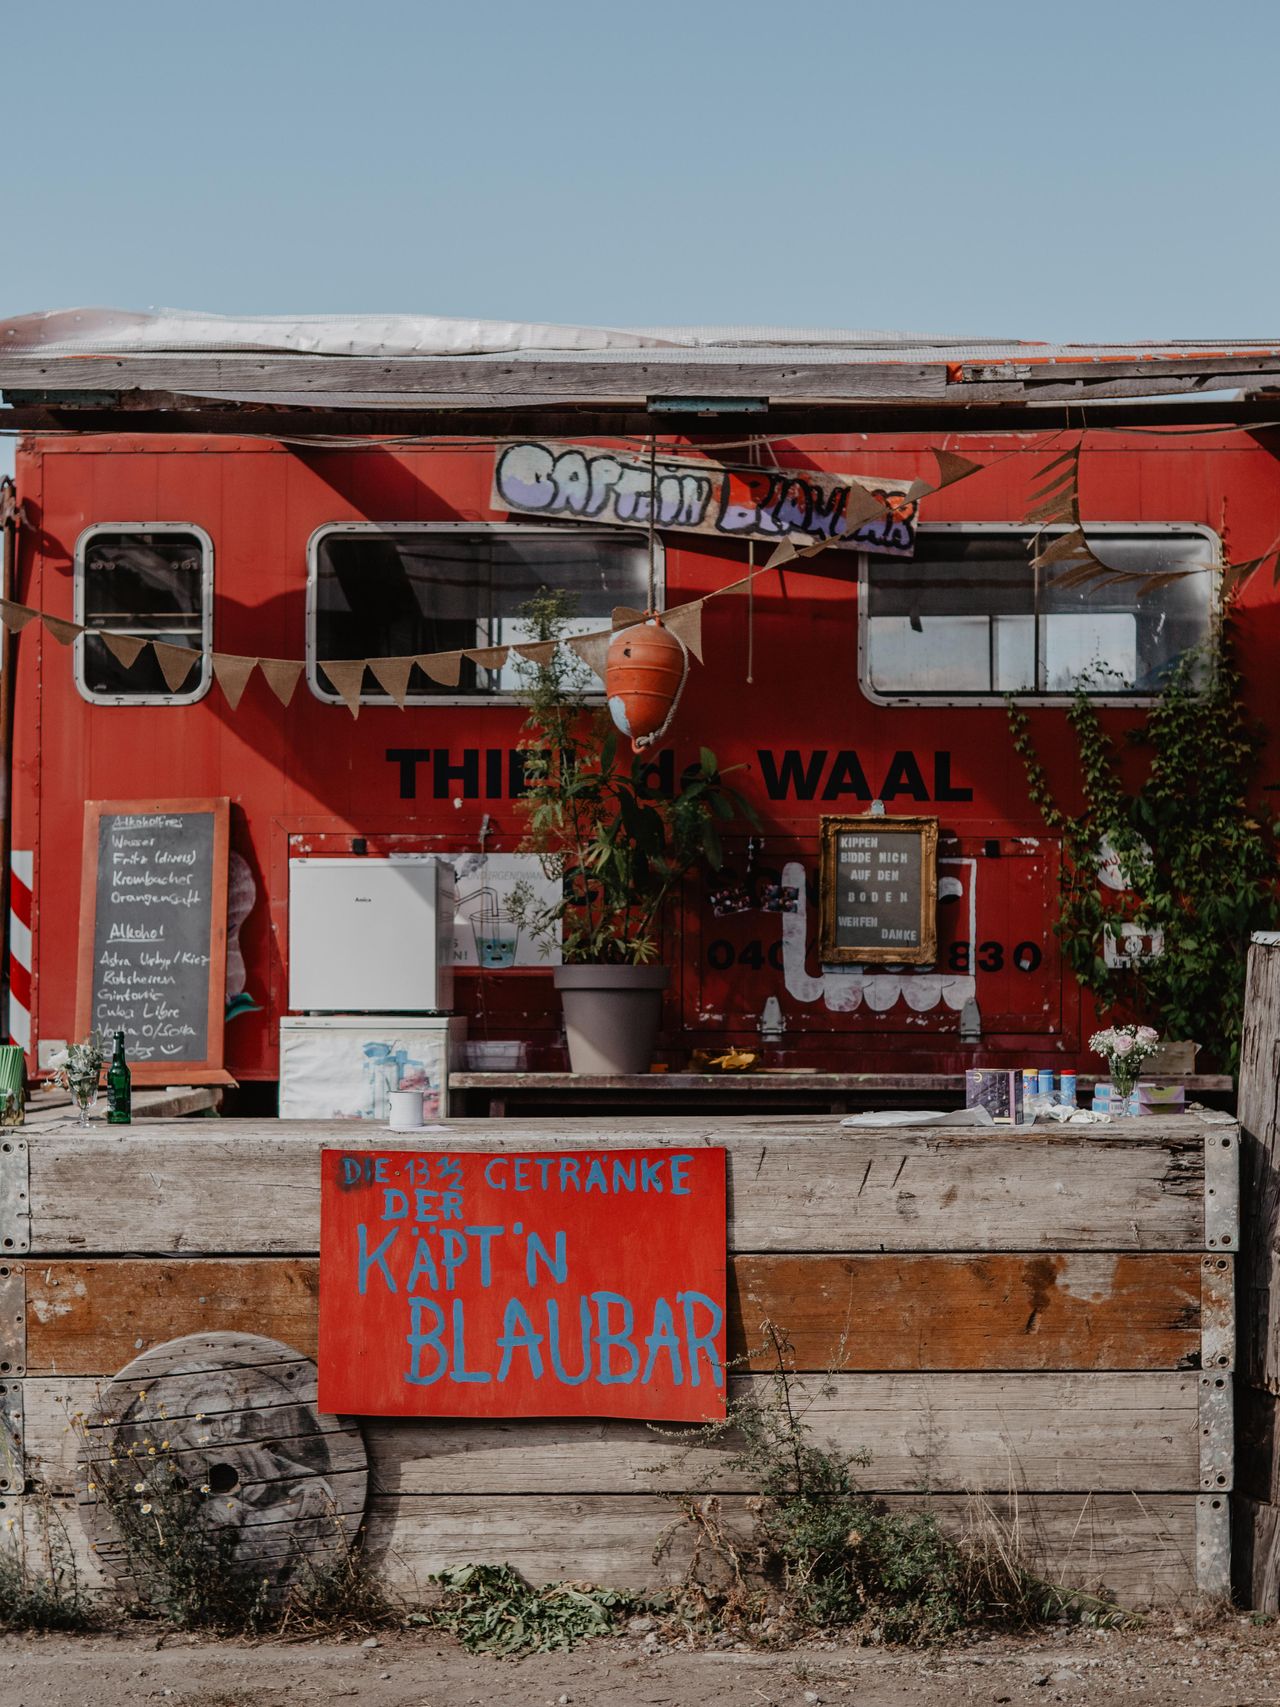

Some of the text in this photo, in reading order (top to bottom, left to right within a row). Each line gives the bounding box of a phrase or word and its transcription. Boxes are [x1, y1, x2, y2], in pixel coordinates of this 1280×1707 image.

[757, 750, 974, 802] WAAL
[112, 835, 155, 848] Wasser
[841, 837, 878, 848] KIPPEN
[841, 852, 871, 863] BIDDE
[113, 871, 193, 886] Krombacher
[850, 870, 899, 880] AUF DEN
[110, 923, 164, 939] Alkohol
[882, 929, 917, 941] DANKE
[100, 951, 131, 967] Astra
[98, 1002, 180, 1019] Cuba Libre
[344, 1157, 391, 1184] DIE
[485, 1154, 695, 1195] GETRÄNKE
[381, 1188, 464, 1222] DER
[357, 1221, 568, 1296] KÄPT'N
[404, 1291, 723, 1388] BLAUBAR
